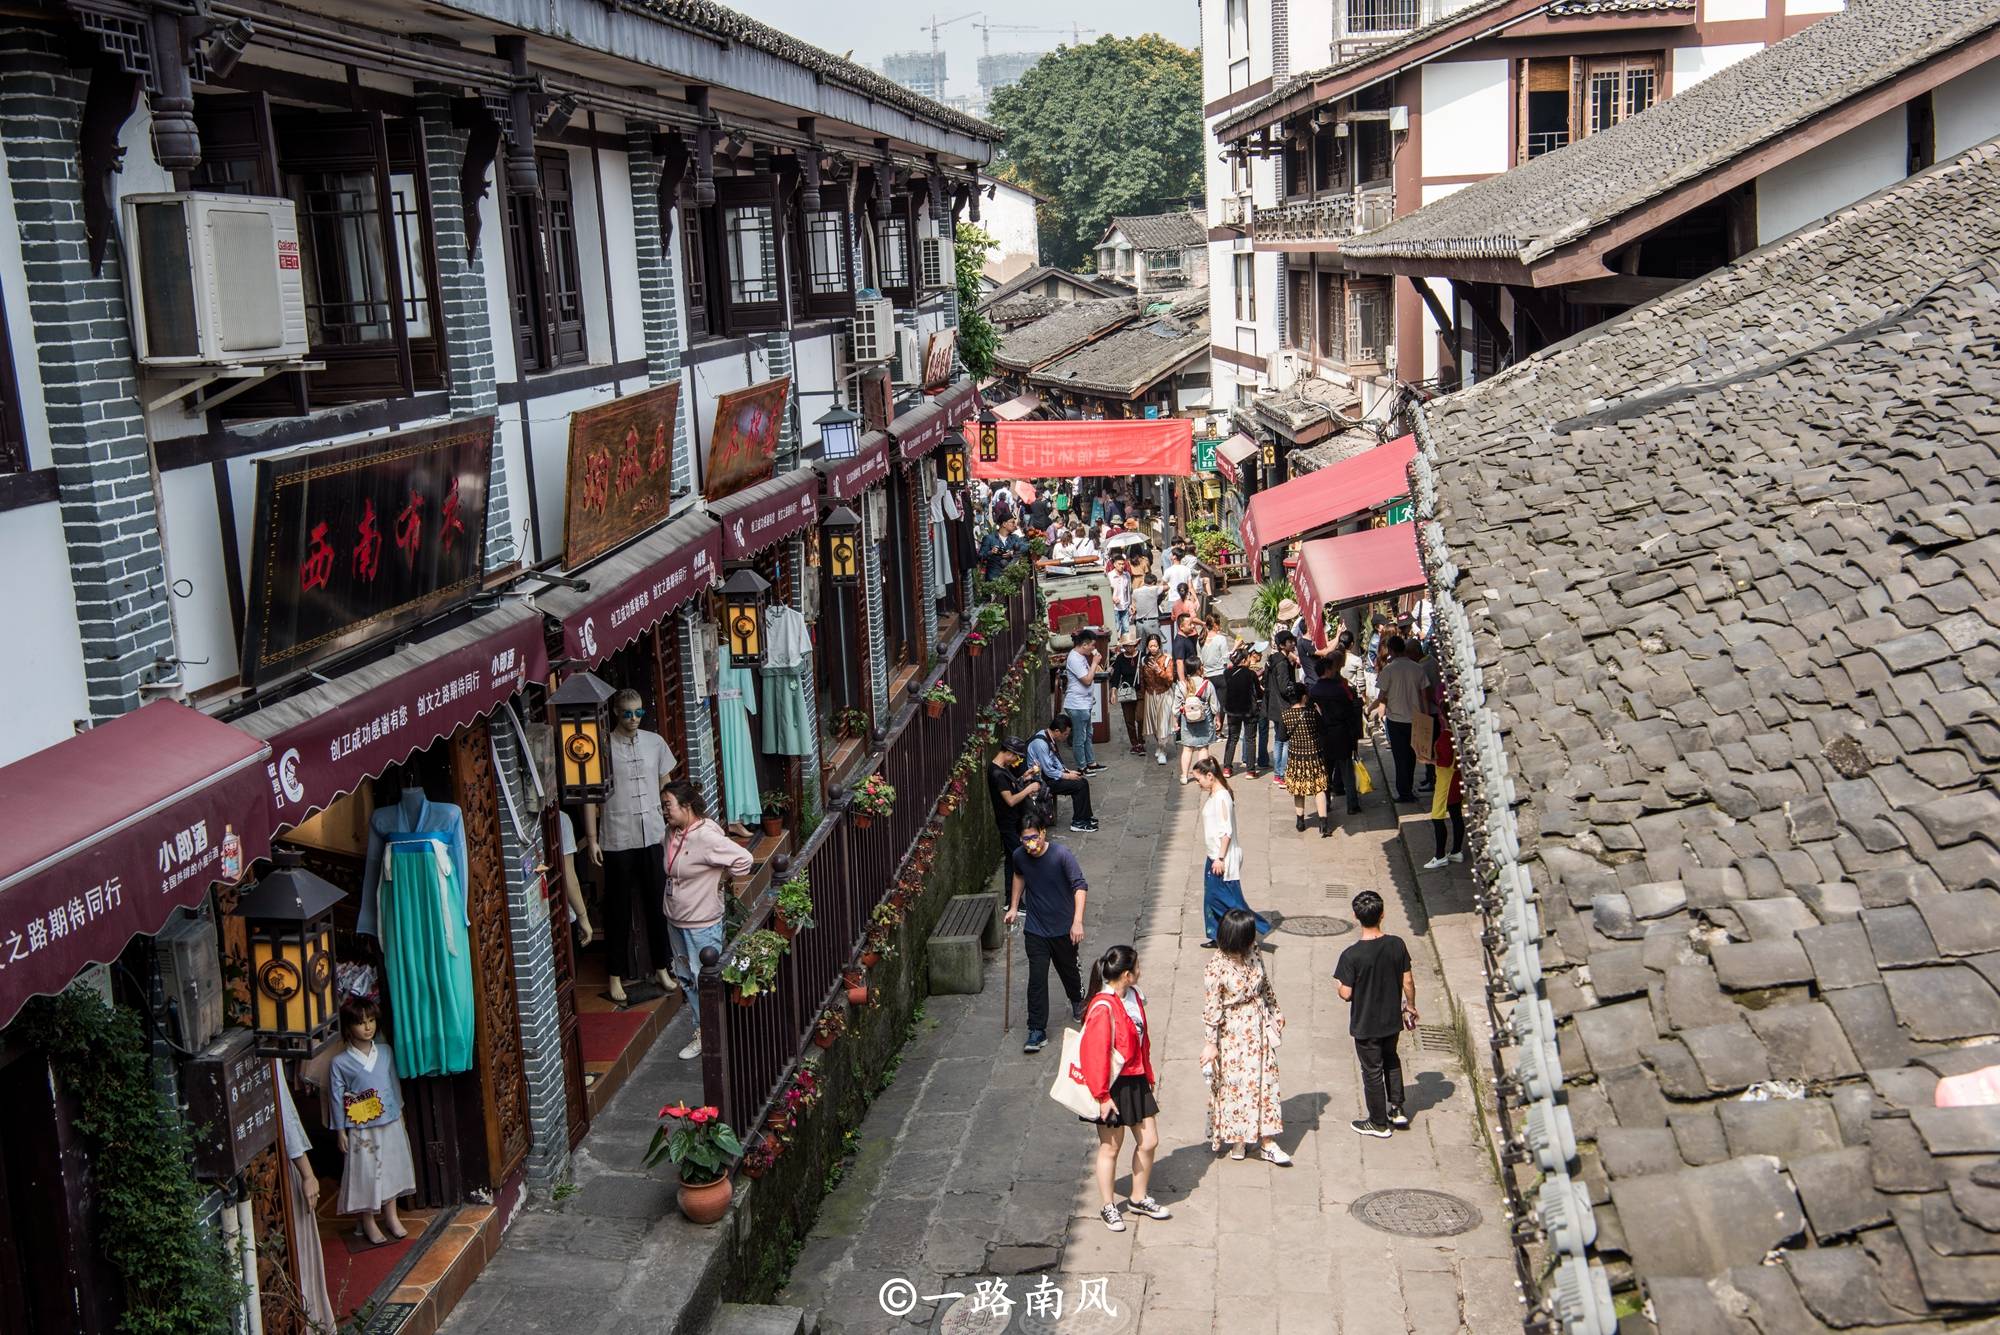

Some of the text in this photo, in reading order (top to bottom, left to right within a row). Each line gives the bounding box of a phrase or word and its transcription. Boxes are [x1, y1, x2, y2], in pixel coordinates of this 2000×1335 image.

[330, 670, 480, 762] 创卫成功感谢有您 创文之路期待同行
[158, 819, 210, 873] 小郎酒
